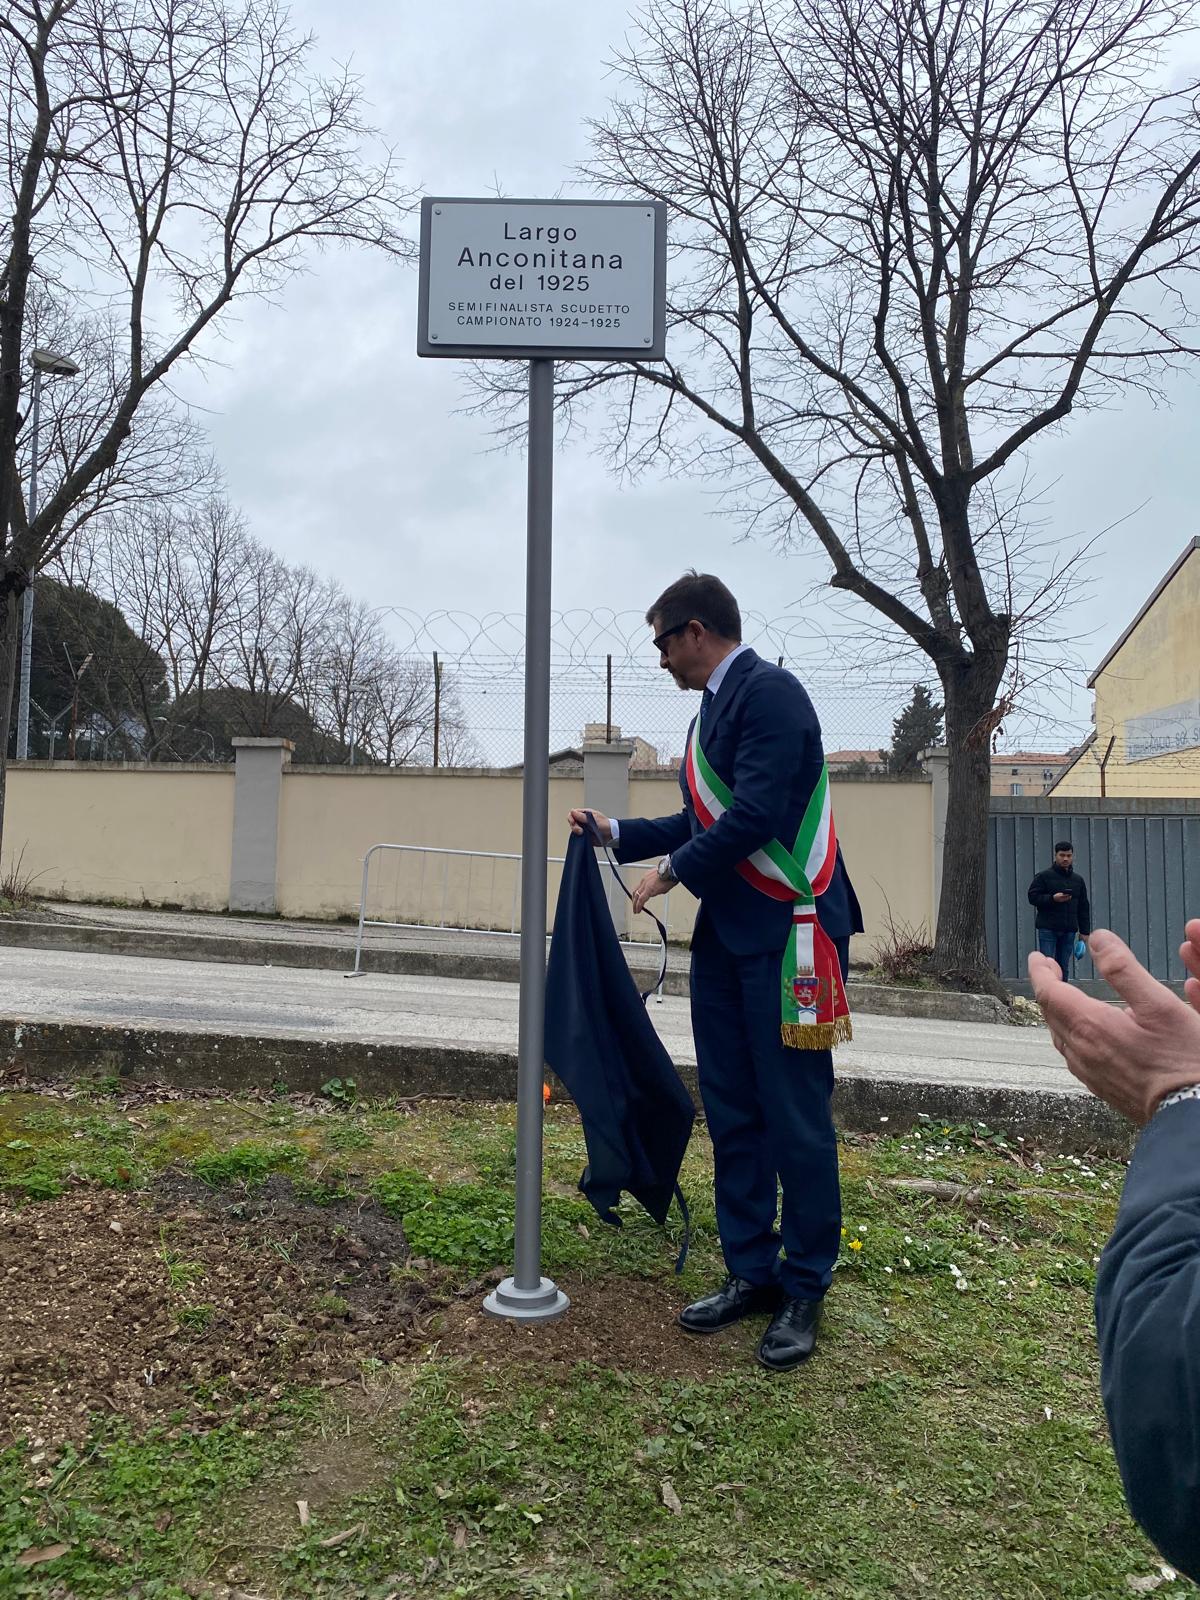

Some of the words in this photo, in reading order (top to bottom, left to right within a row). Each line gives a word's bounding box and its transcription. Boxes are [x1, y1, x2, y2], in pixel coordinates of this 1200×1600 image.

[504, 222, 577, 244] Largo
[457, 247, 623, 269] Anconitana
[489, 274, 523, 290] del
[537, 275, 590, 291] 1925
[448, 302, 553, 313] SEMIFINALISTA
[561, 304, 630, 314] SCUDETTO
[457, 315, 542, 326] CAMPIONATO
[550, 317, 621, 328] 1924-1925
